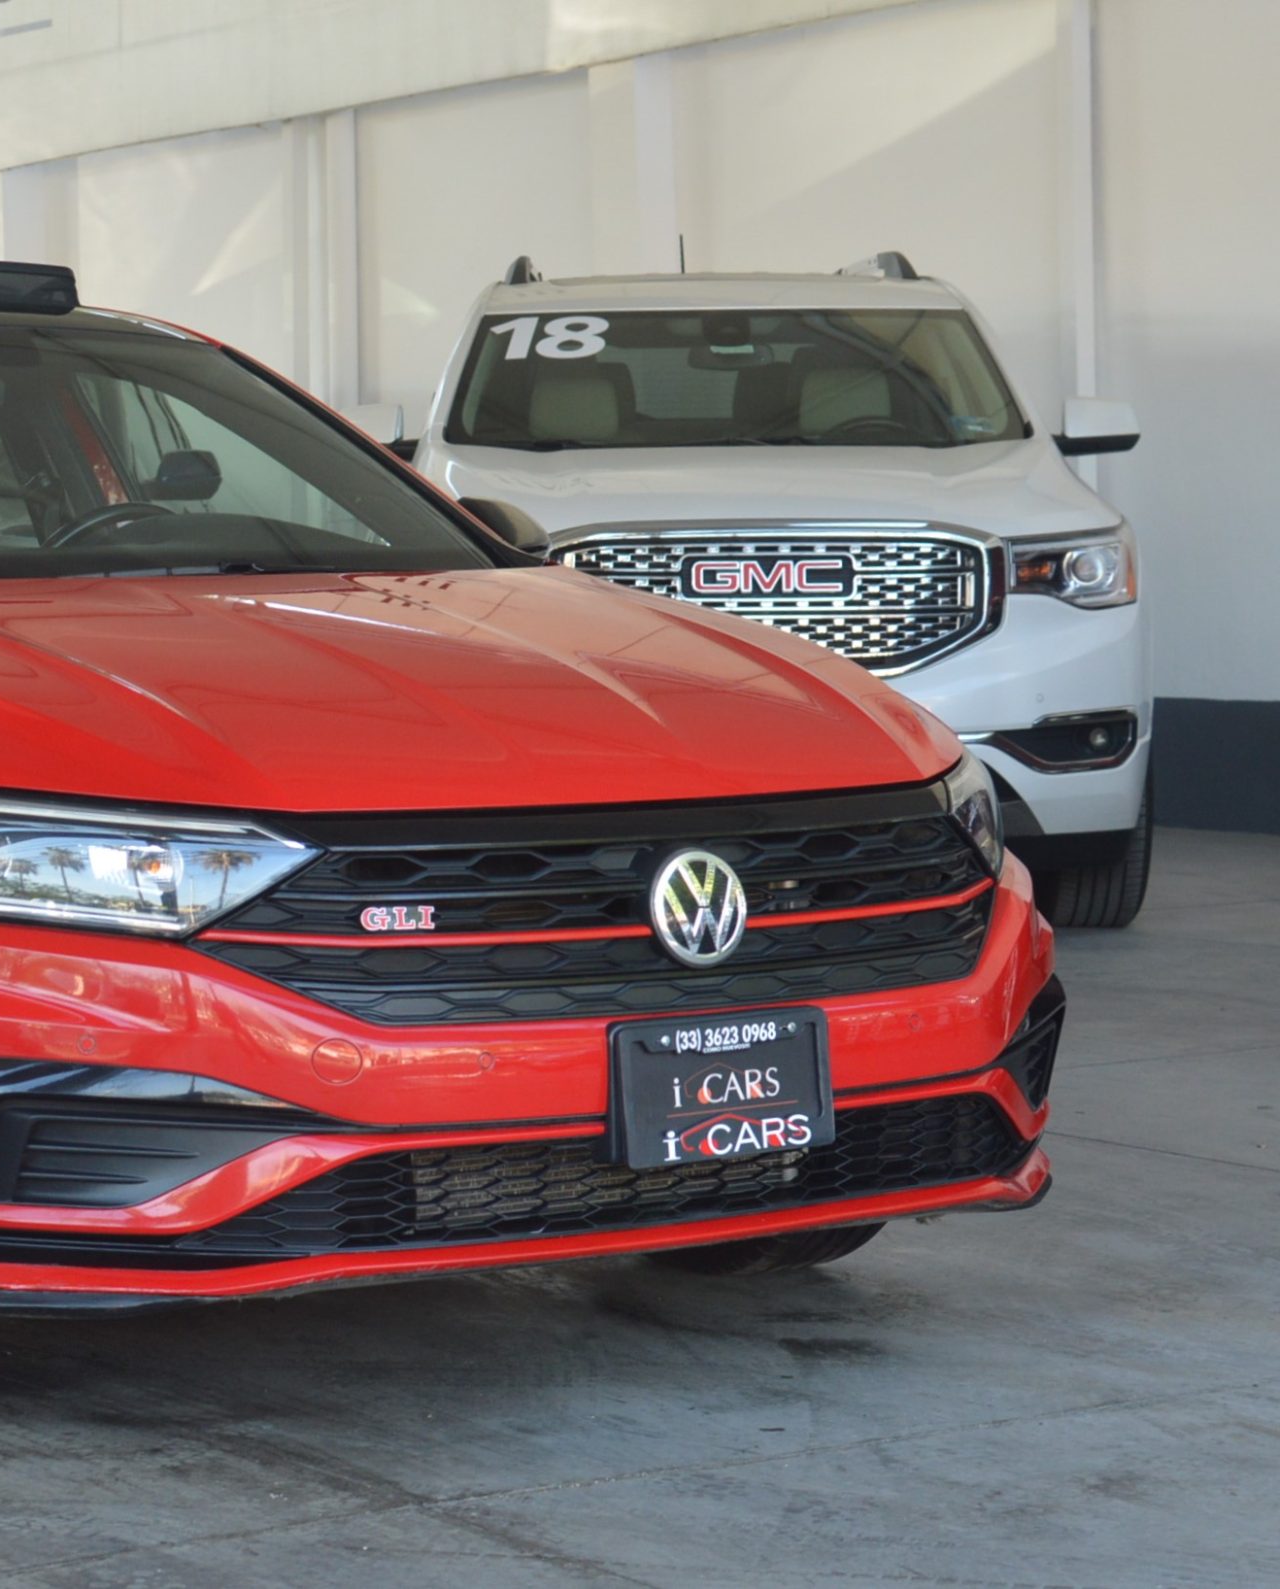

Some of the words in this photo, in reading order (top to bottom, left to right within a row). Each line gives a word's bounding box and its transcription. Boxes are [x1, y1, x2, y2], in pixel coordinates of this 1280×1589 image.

[489, 315, 610, 360] 18
[691, 560, 843, 593] GMC
[360, 905, 435, 931] GLI
[675, 1028, 702, 1054] (33)
[704, 1026, 739, 1047] 3623
[742, 1021, 777, 1042] 0968
[673, 1077, 683, 1108] i
[703, 1066, 781, 1104] CARS
[662, 1130, 682, 1161] i
[706, 1113, 812, 1156] CARS
